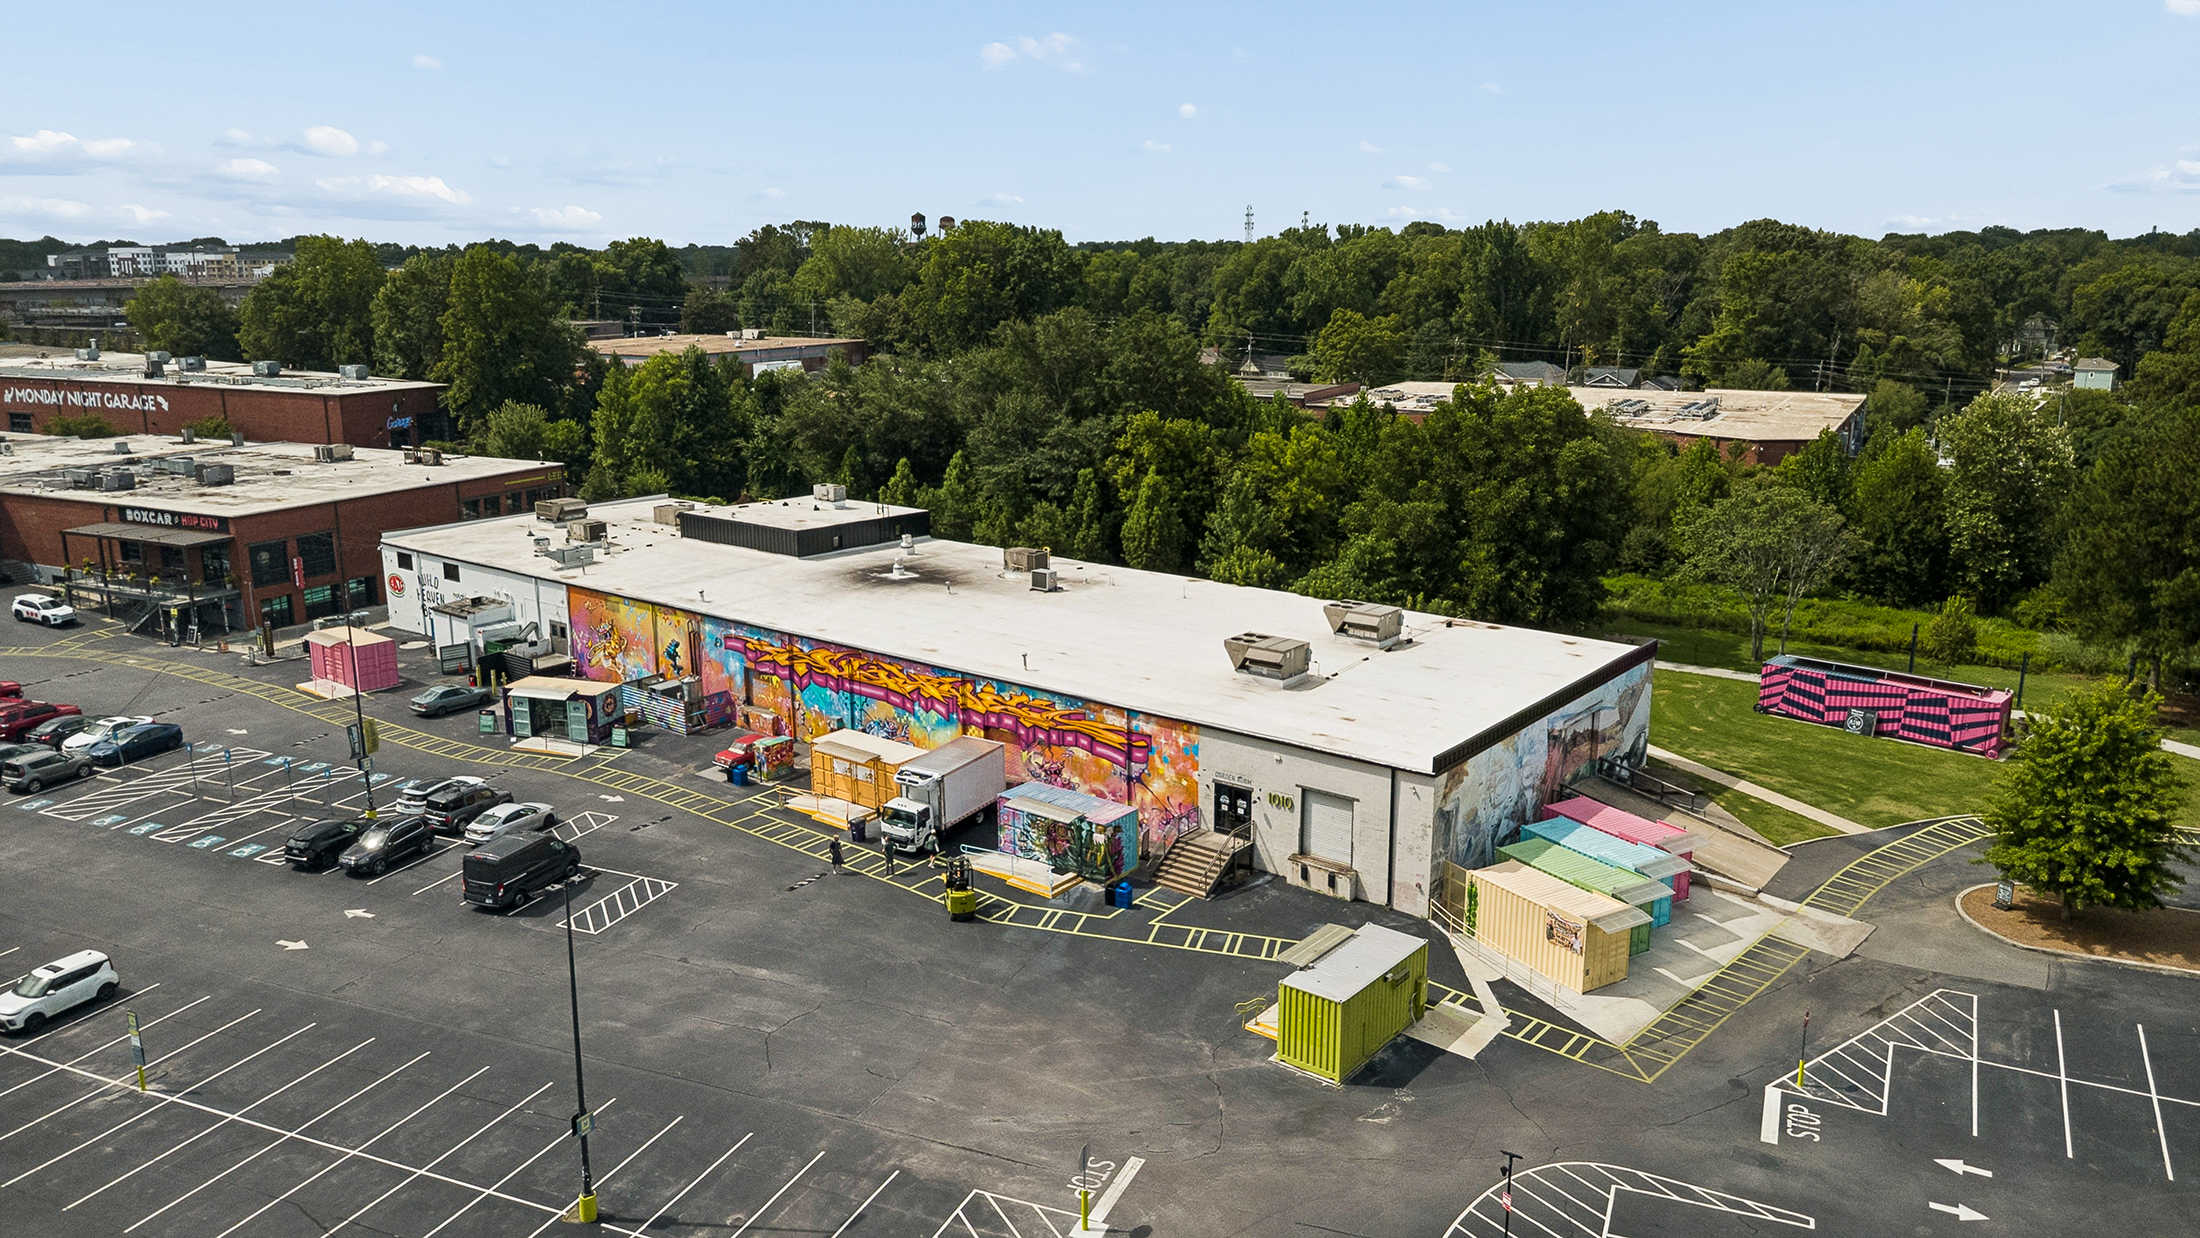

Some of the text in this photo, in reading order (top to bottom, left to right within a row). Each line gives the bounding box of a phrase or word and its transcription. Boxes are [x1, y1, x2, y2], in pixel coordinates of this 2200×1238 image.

[15, 388, 156, 411] MONDAY NIGHT GARAGE
[125, 508, 172, 525] BOXCAR
[181, 515, 198, 526] HOP
[200, 517, 219, 529] CITY
[418, 573, 439, 590] WILD
[416, 588, 446, 606] HEAVEN
[1268, 792, 1293, 809] 1010
[1786, 1103, 1821, 1142] STOP
[1066, 1156, 1116, 1200] STOP
